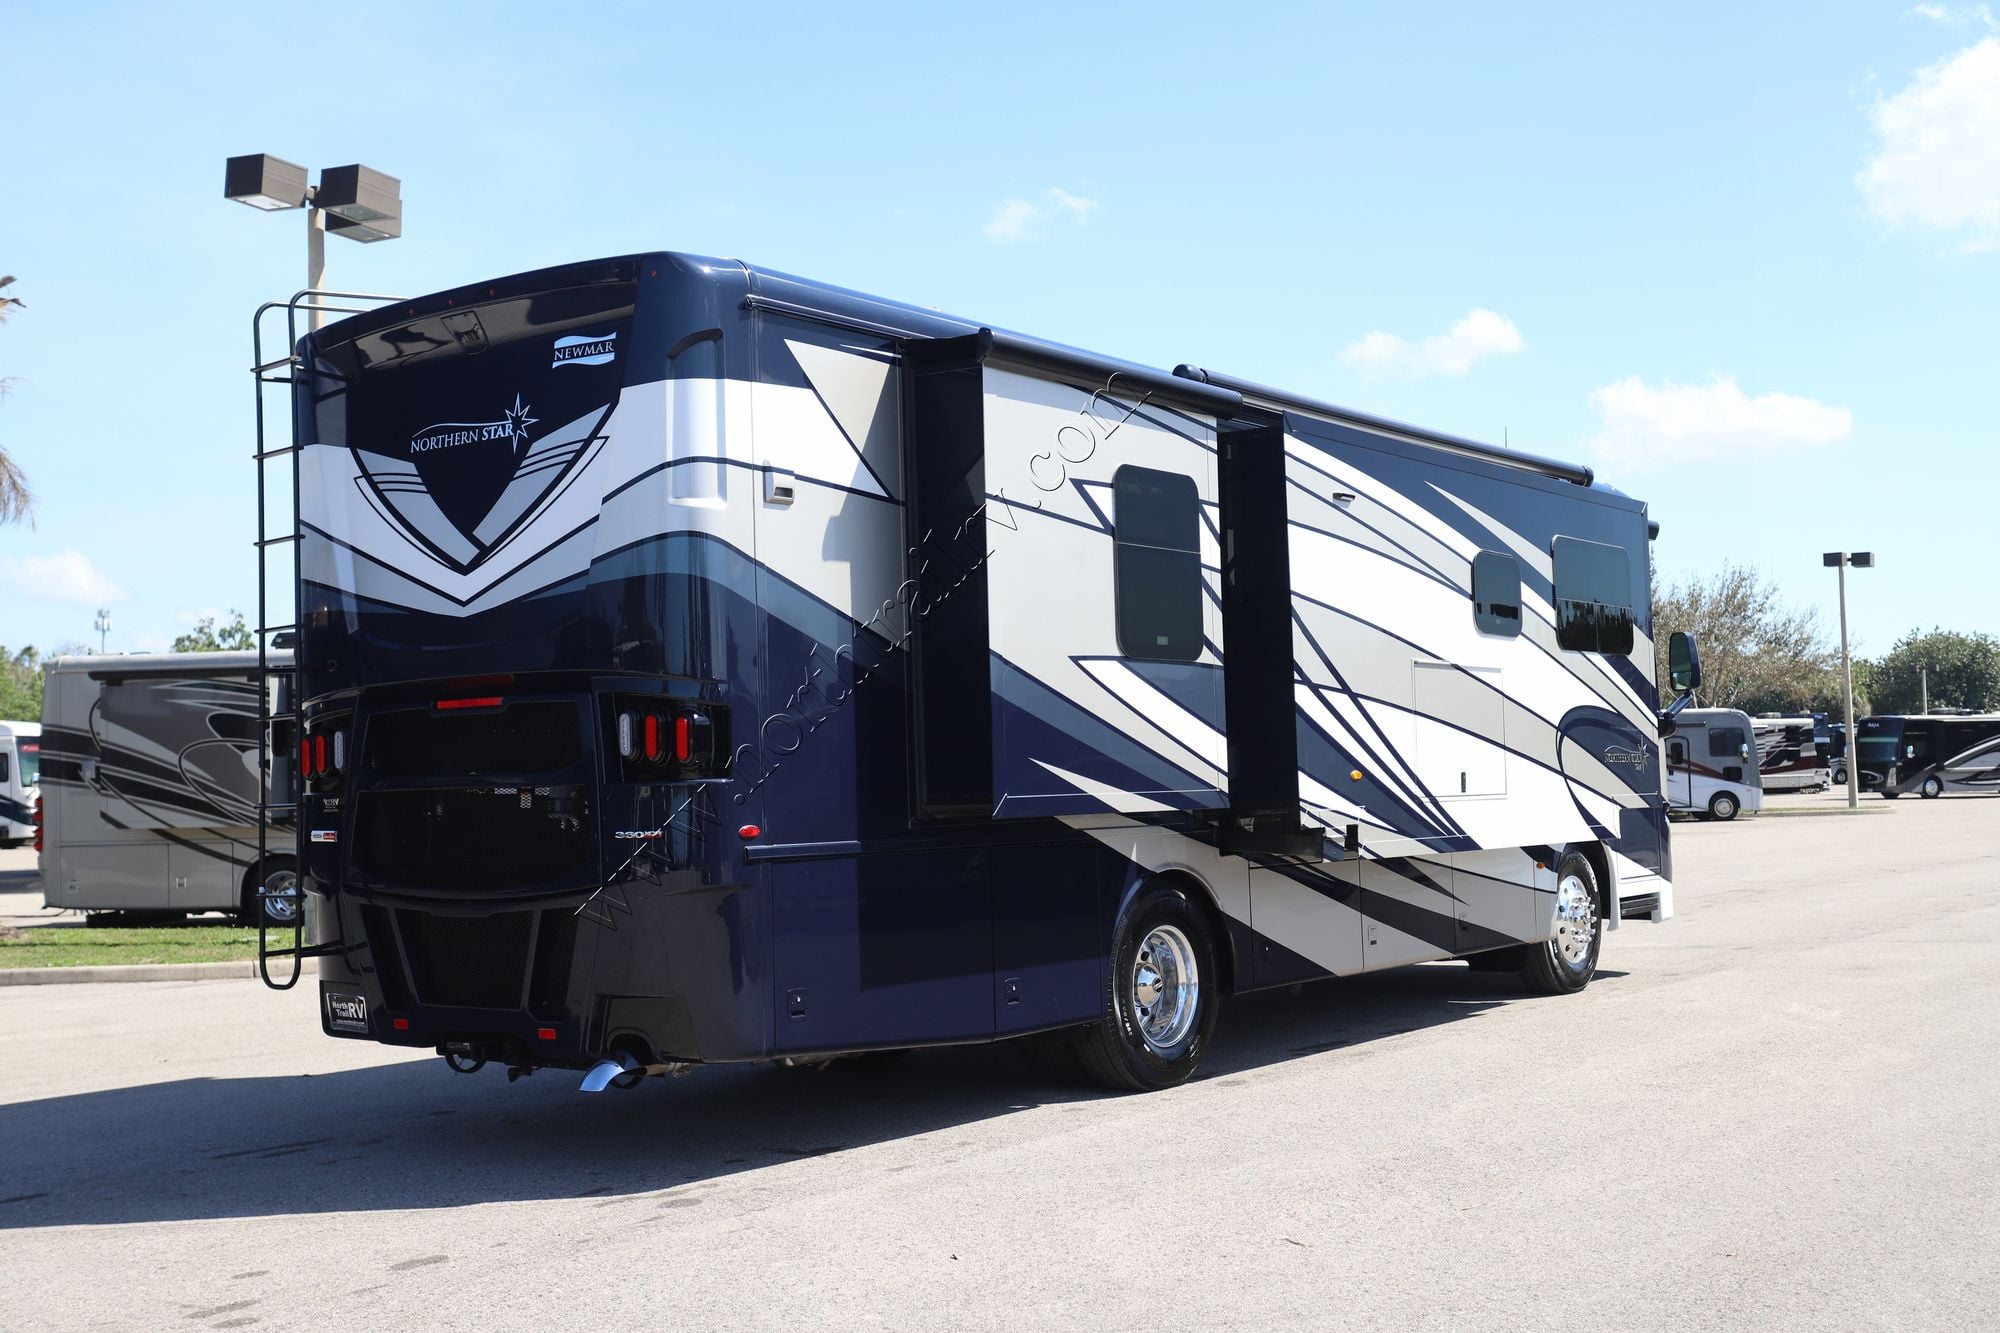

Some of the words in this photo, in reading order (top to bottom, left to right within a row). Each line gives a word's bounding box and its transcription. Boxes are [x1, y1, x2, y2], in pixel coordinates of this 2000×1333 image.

[554, 341, 614, 361] NEWMAR
[410, 429, 479, 453] NORTHERN
[482, 423, 514, 441] STAR
[332, 1001, 348, 1009] North
[348, 1002, 363, 1018] RV
